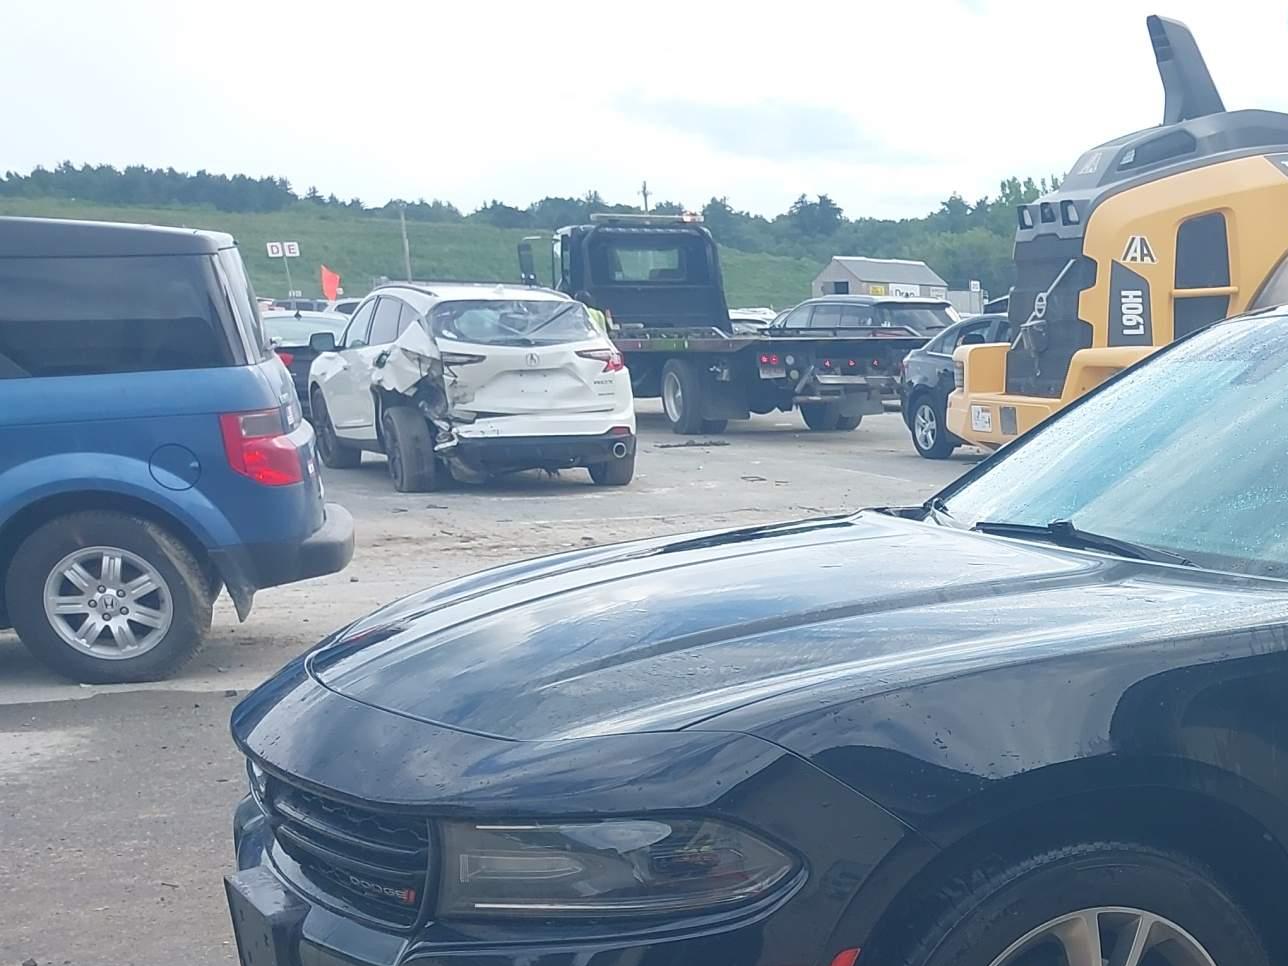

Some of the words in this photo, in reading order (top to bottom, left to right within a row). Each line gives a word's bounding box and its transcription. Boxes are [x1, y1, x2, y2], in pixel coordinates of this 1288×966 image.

[270, 244, 280, 255] D
[287, 244, 297, 255] E
[1120, 290, 1145, 335] L90H
